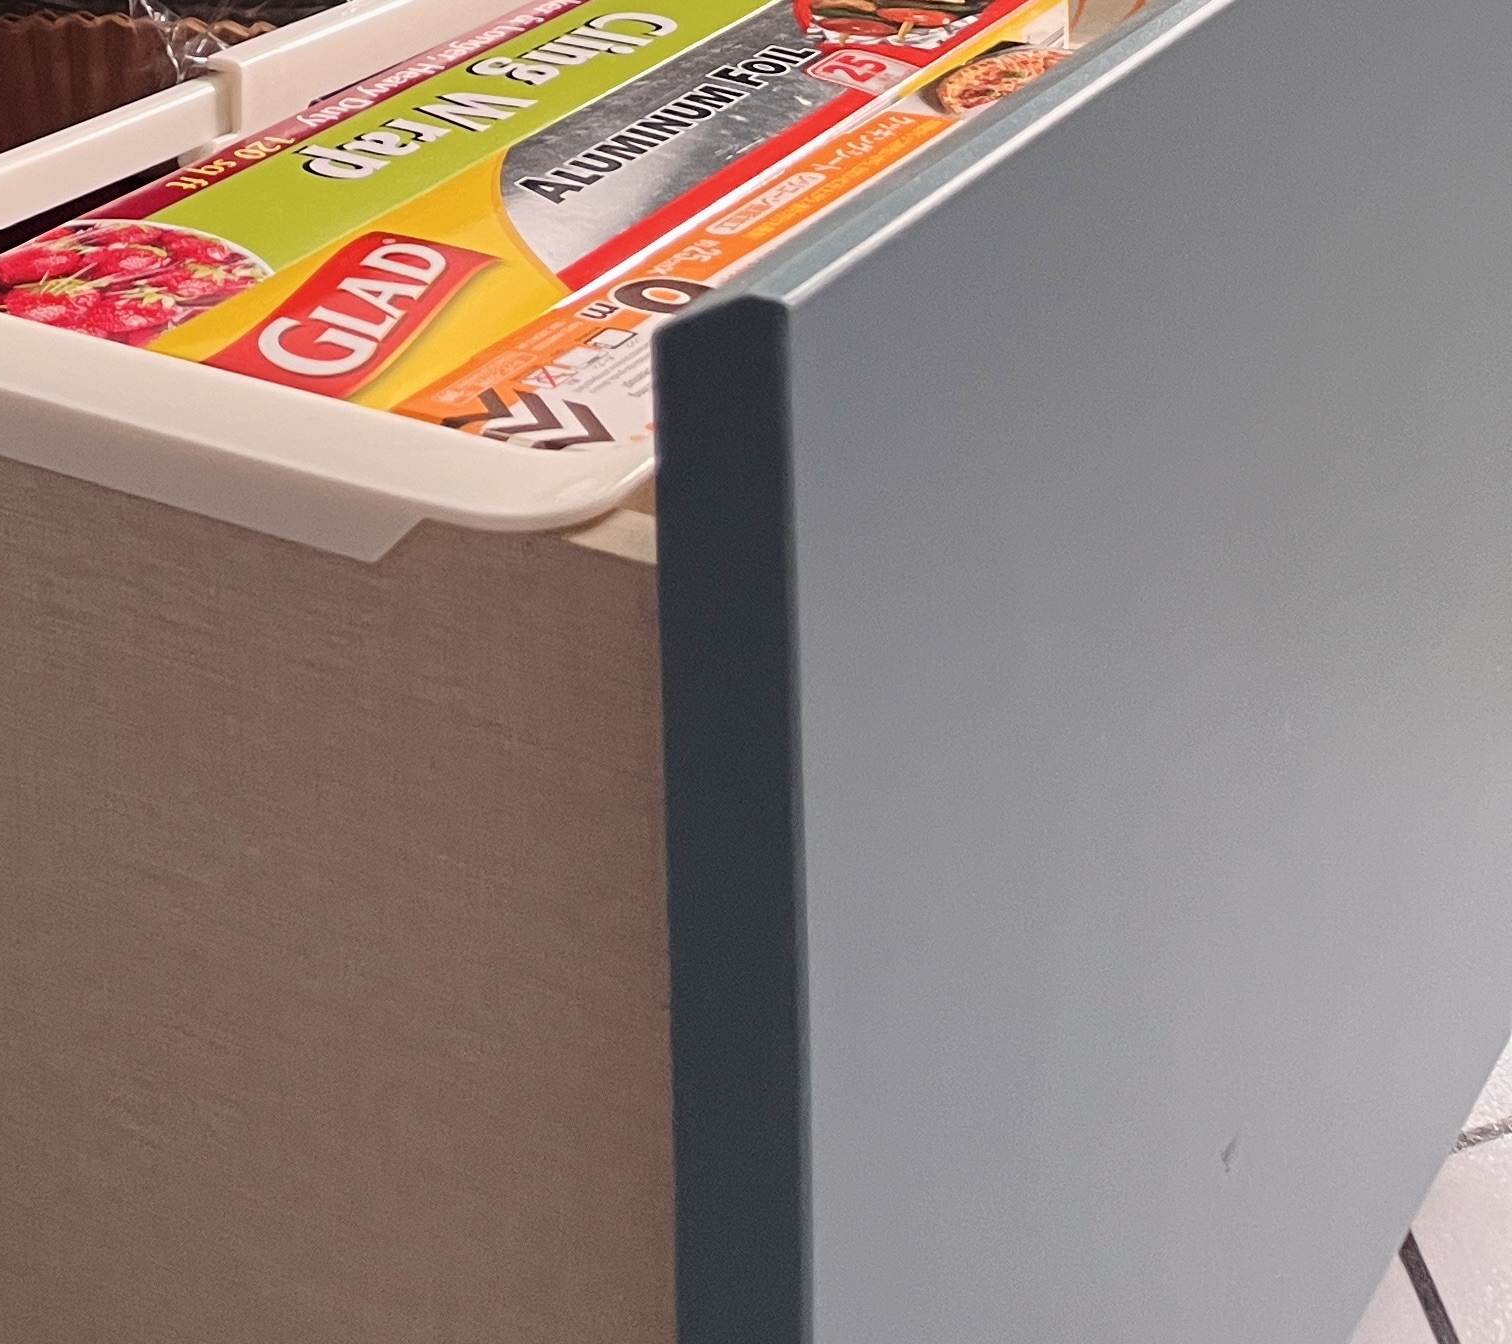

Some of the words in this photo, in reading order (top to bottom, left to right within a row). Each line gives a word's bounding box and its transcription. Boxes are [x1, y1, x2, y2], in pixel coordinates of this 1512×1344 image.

[466, 12, 678, 86] Cling
[356, 62, 445, 98] Heavy
[822, 55, 887, 83] 25
[296, 98, 374, 128] Duty
[516, 81, 750, 205] ALUMINUM
[706, 45, 821, 89] FOIL
[234, 136, 295, 161] 120
[292, 92, 538, 180] Wrap
[165, 175, 209, 190] ft
[186, 158, 237, 177] sq
[258, 243, 447, 376] GLAD
